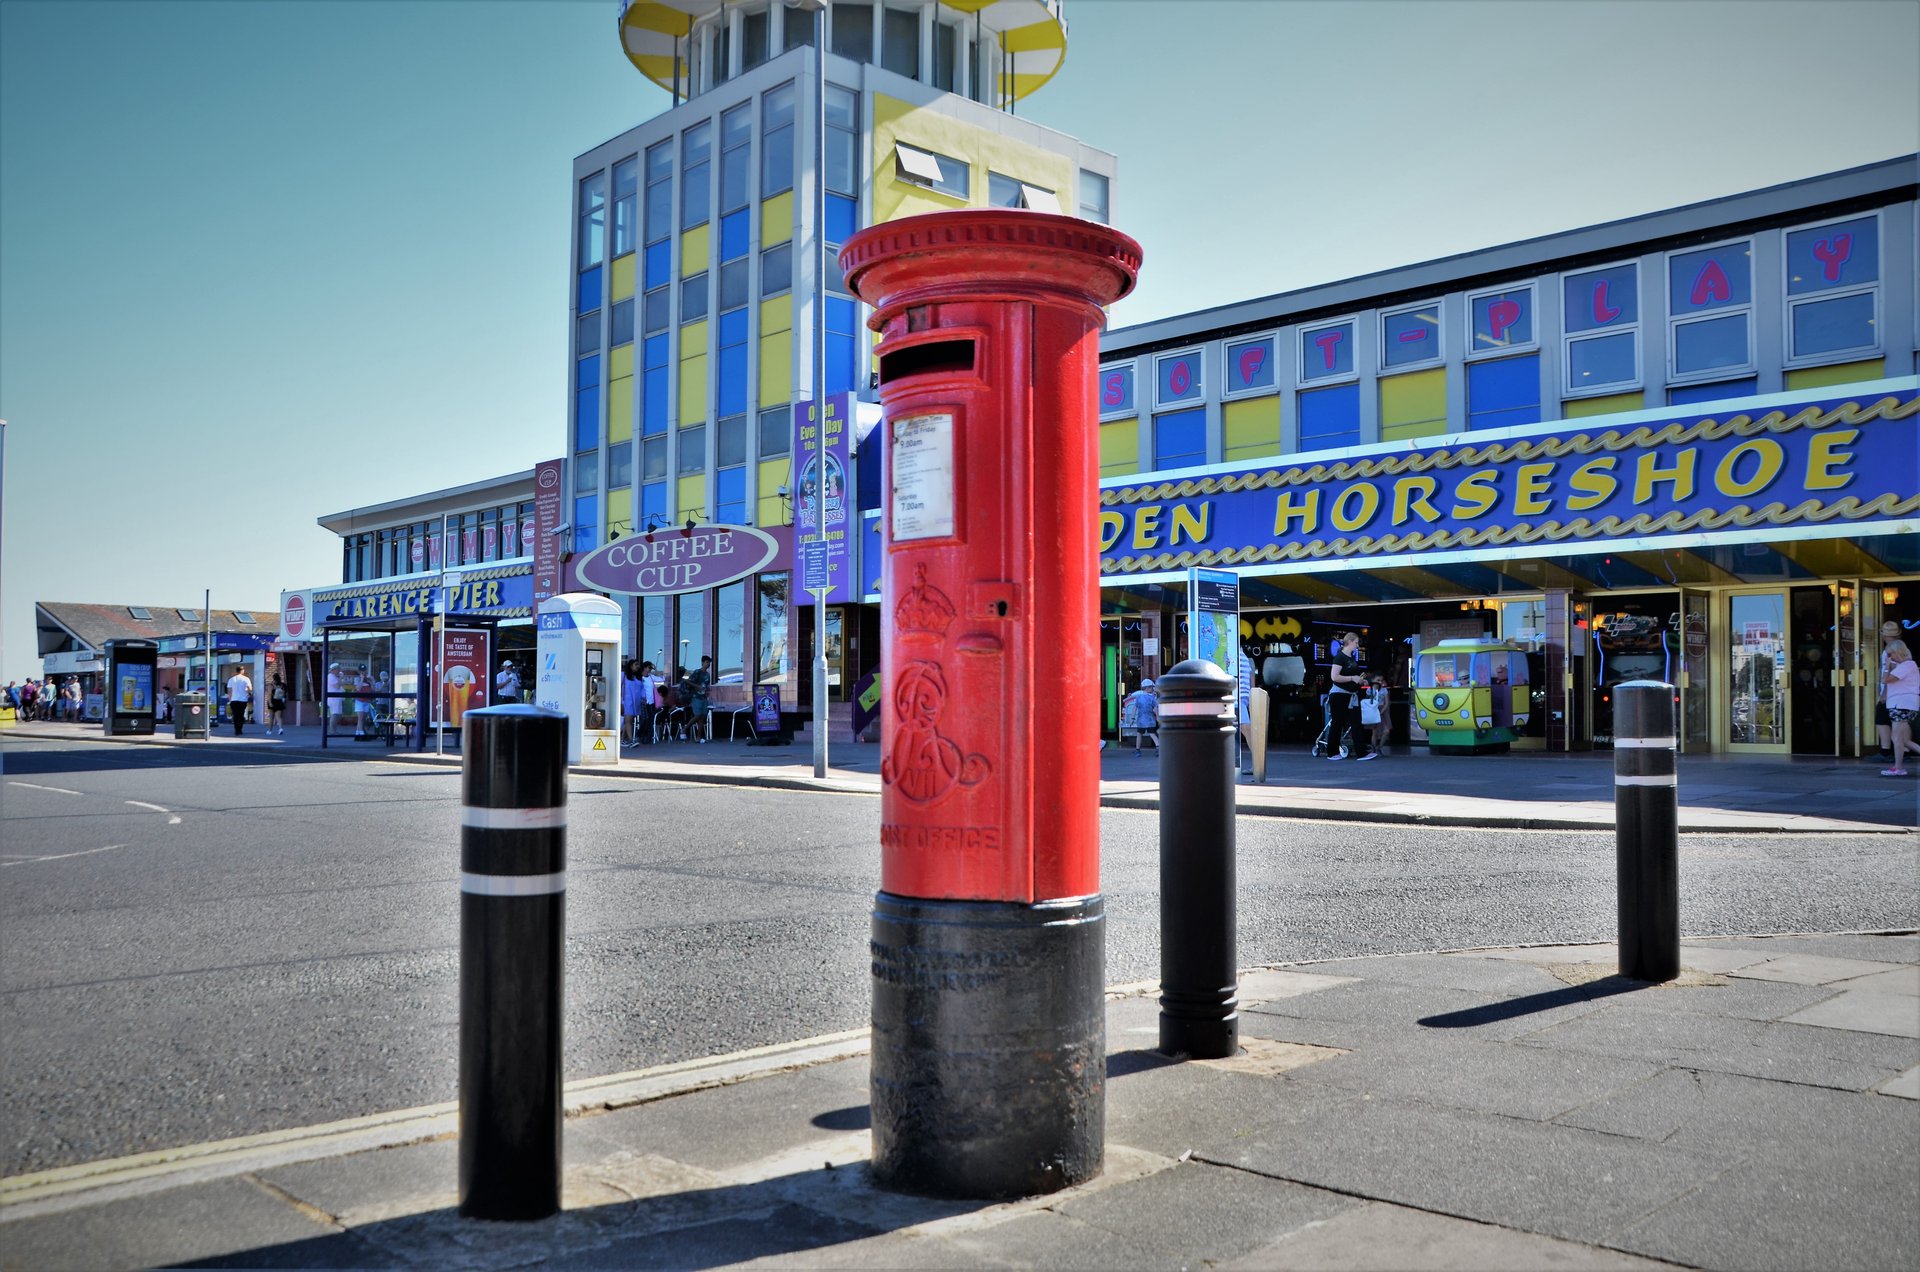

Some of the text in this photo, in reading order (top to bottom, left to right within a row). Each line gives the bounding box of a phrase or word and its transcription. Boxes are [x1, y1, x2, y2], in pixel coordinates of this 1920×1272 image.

[825, 419, 843, 435] Day
[1273, 429, 1860, 537] HORSESHOE
[428, 523, 517, 566] WIMPY
[607, 531, 734, 568] COFFEE
[636, 562, 702, 589] CUP
[450, 580, 500, 612] PIER
[542, 614, 563, 628] Cash
[542, 700, 553, 710] Safe
[917, 825, 1001, 850] OFFICE
